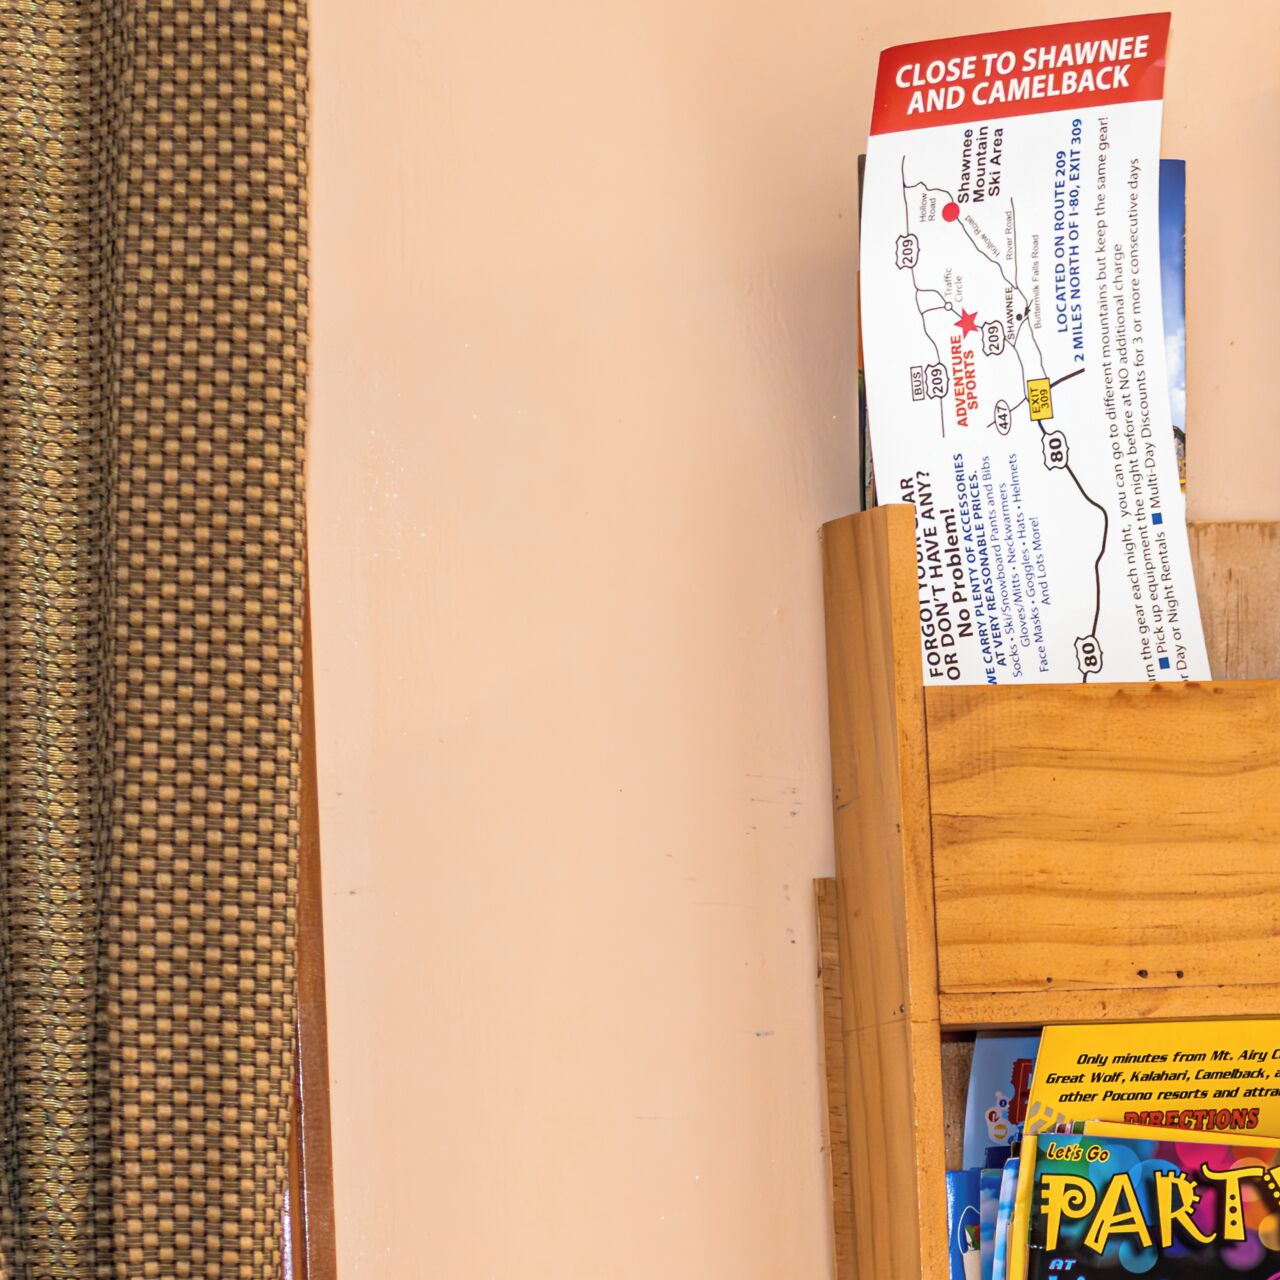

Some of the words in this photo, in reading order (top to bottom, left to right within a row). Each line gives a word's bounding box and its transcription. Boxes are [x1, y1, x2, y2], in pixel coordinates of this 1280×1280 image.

[895, 57, 977, 88] CLOSE
[982, 51, 1016, 76] TO
[1022, 34, 1150, 72] SHAWNEE
[906, 85, 966, 115] AND
[972, 63, 1131, 105] CAMELBACK
[957, 129, 973, 203] Shawnee
[972, 126, 989, 202] Mountain
[991, 128, 1004, 170] Area
[1056, 151, 1066, 177] 209
[988, 172, 1001, 197] Ski
[1054, 180, 1065, 231] ROUTE
[1054, 234, 1065, 259] ON
[1055, 263, 1068, 333] LOCATED
[950, 335, 968, 427] ADVENTURE
[964, 350, 978, 410] SPORTS
[940, 507, 967, 603] Problem!
[959, 608, 973, 638] No
[1045, 1073, 1085, 1084] Great
[1090, 1072, 1127, 1084] Wolf,
[1130, 1070, 1191, 1083] Kalahari,
[1194, 1068, 1270, 1080] Camelback,
[1076, 1054, 1108, 1066] Only
[1112, 1053, 1169, 1064] minutes
[1172, 1051, 1207, 1062] from
[1210, 1050, 1235, 1061] Mt.
[1238, 1050, 1268, 1062] Airy
[1058, 1091, 1098, 1103] other
[1102, 1090, 1153, 1101] Pocono
[1156, 1088, 1209, 1100] resorts
[1212, 1087, 1240, 1098] and
[1046, 1142, 1082, 1161] Let's
[1086, 1145, 1110, 1163] Go
